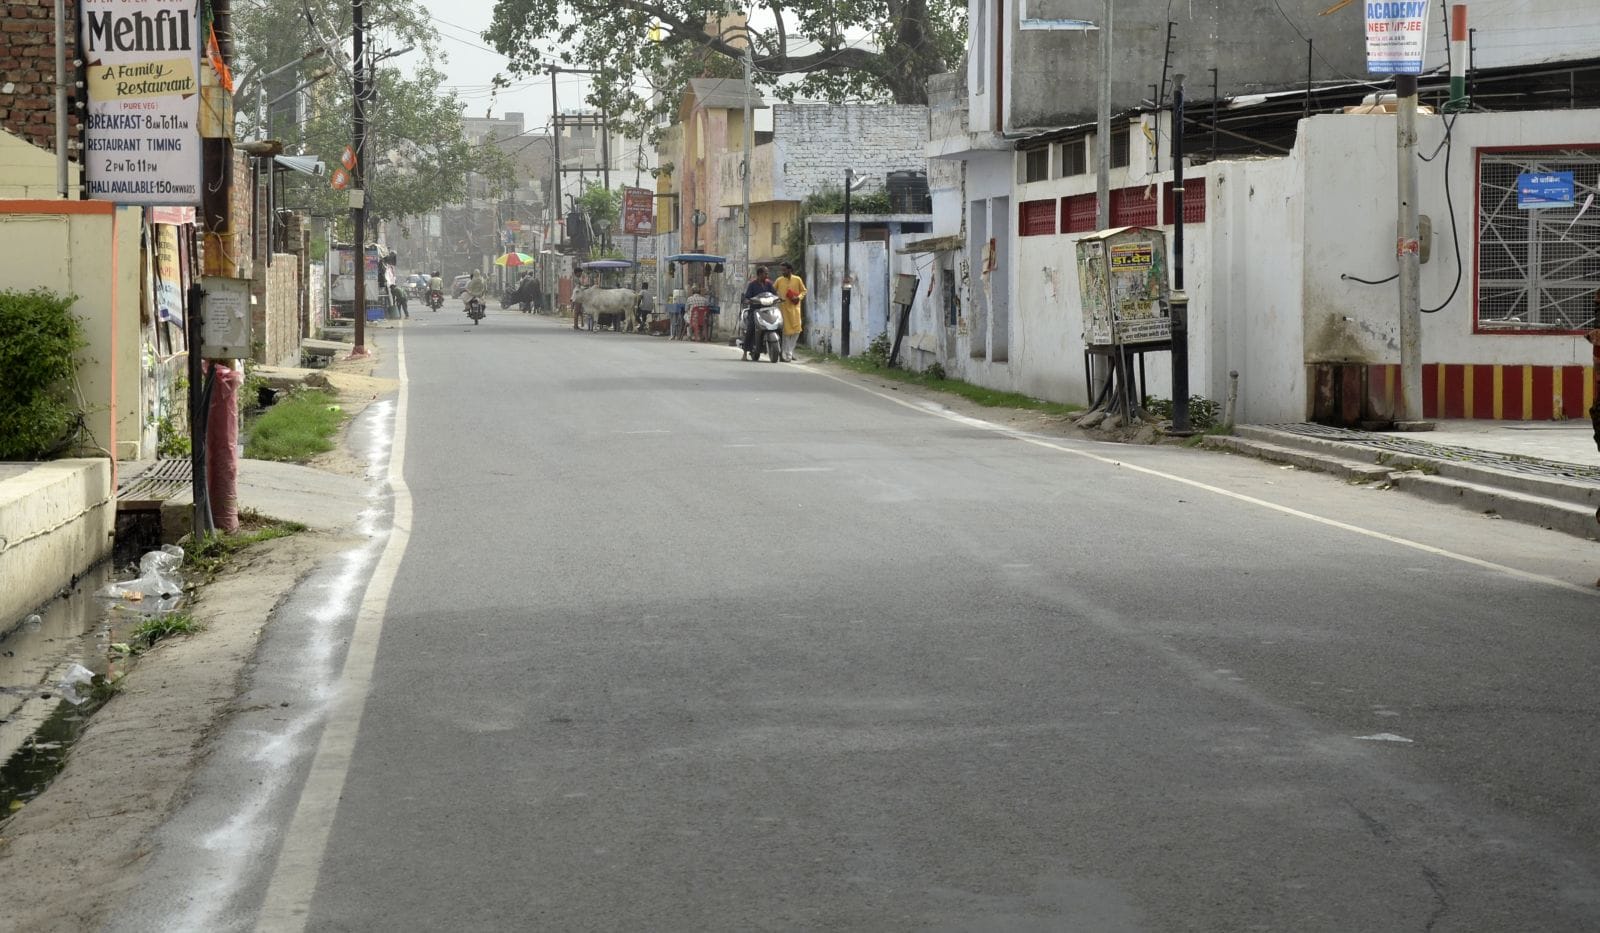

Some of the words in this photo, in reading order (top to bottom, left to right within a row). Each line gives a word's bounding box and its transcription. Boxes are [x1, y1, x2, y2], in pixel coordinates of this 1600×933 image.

[1368, 2, 1425, 19] ACADEMY
[87, 9, 191, 52] Mehfil
[1368, 22, 1390, 32] NEET
[102, 66, 115, 80] A
[118, 63, 172, 79] Family
[116, 76, 195, 96] Restaurant
[88, 138, 140, 151] RESTAURANT
[147, 138, 182, 151] TIMING
[86, 180, 110, 194] THALI
